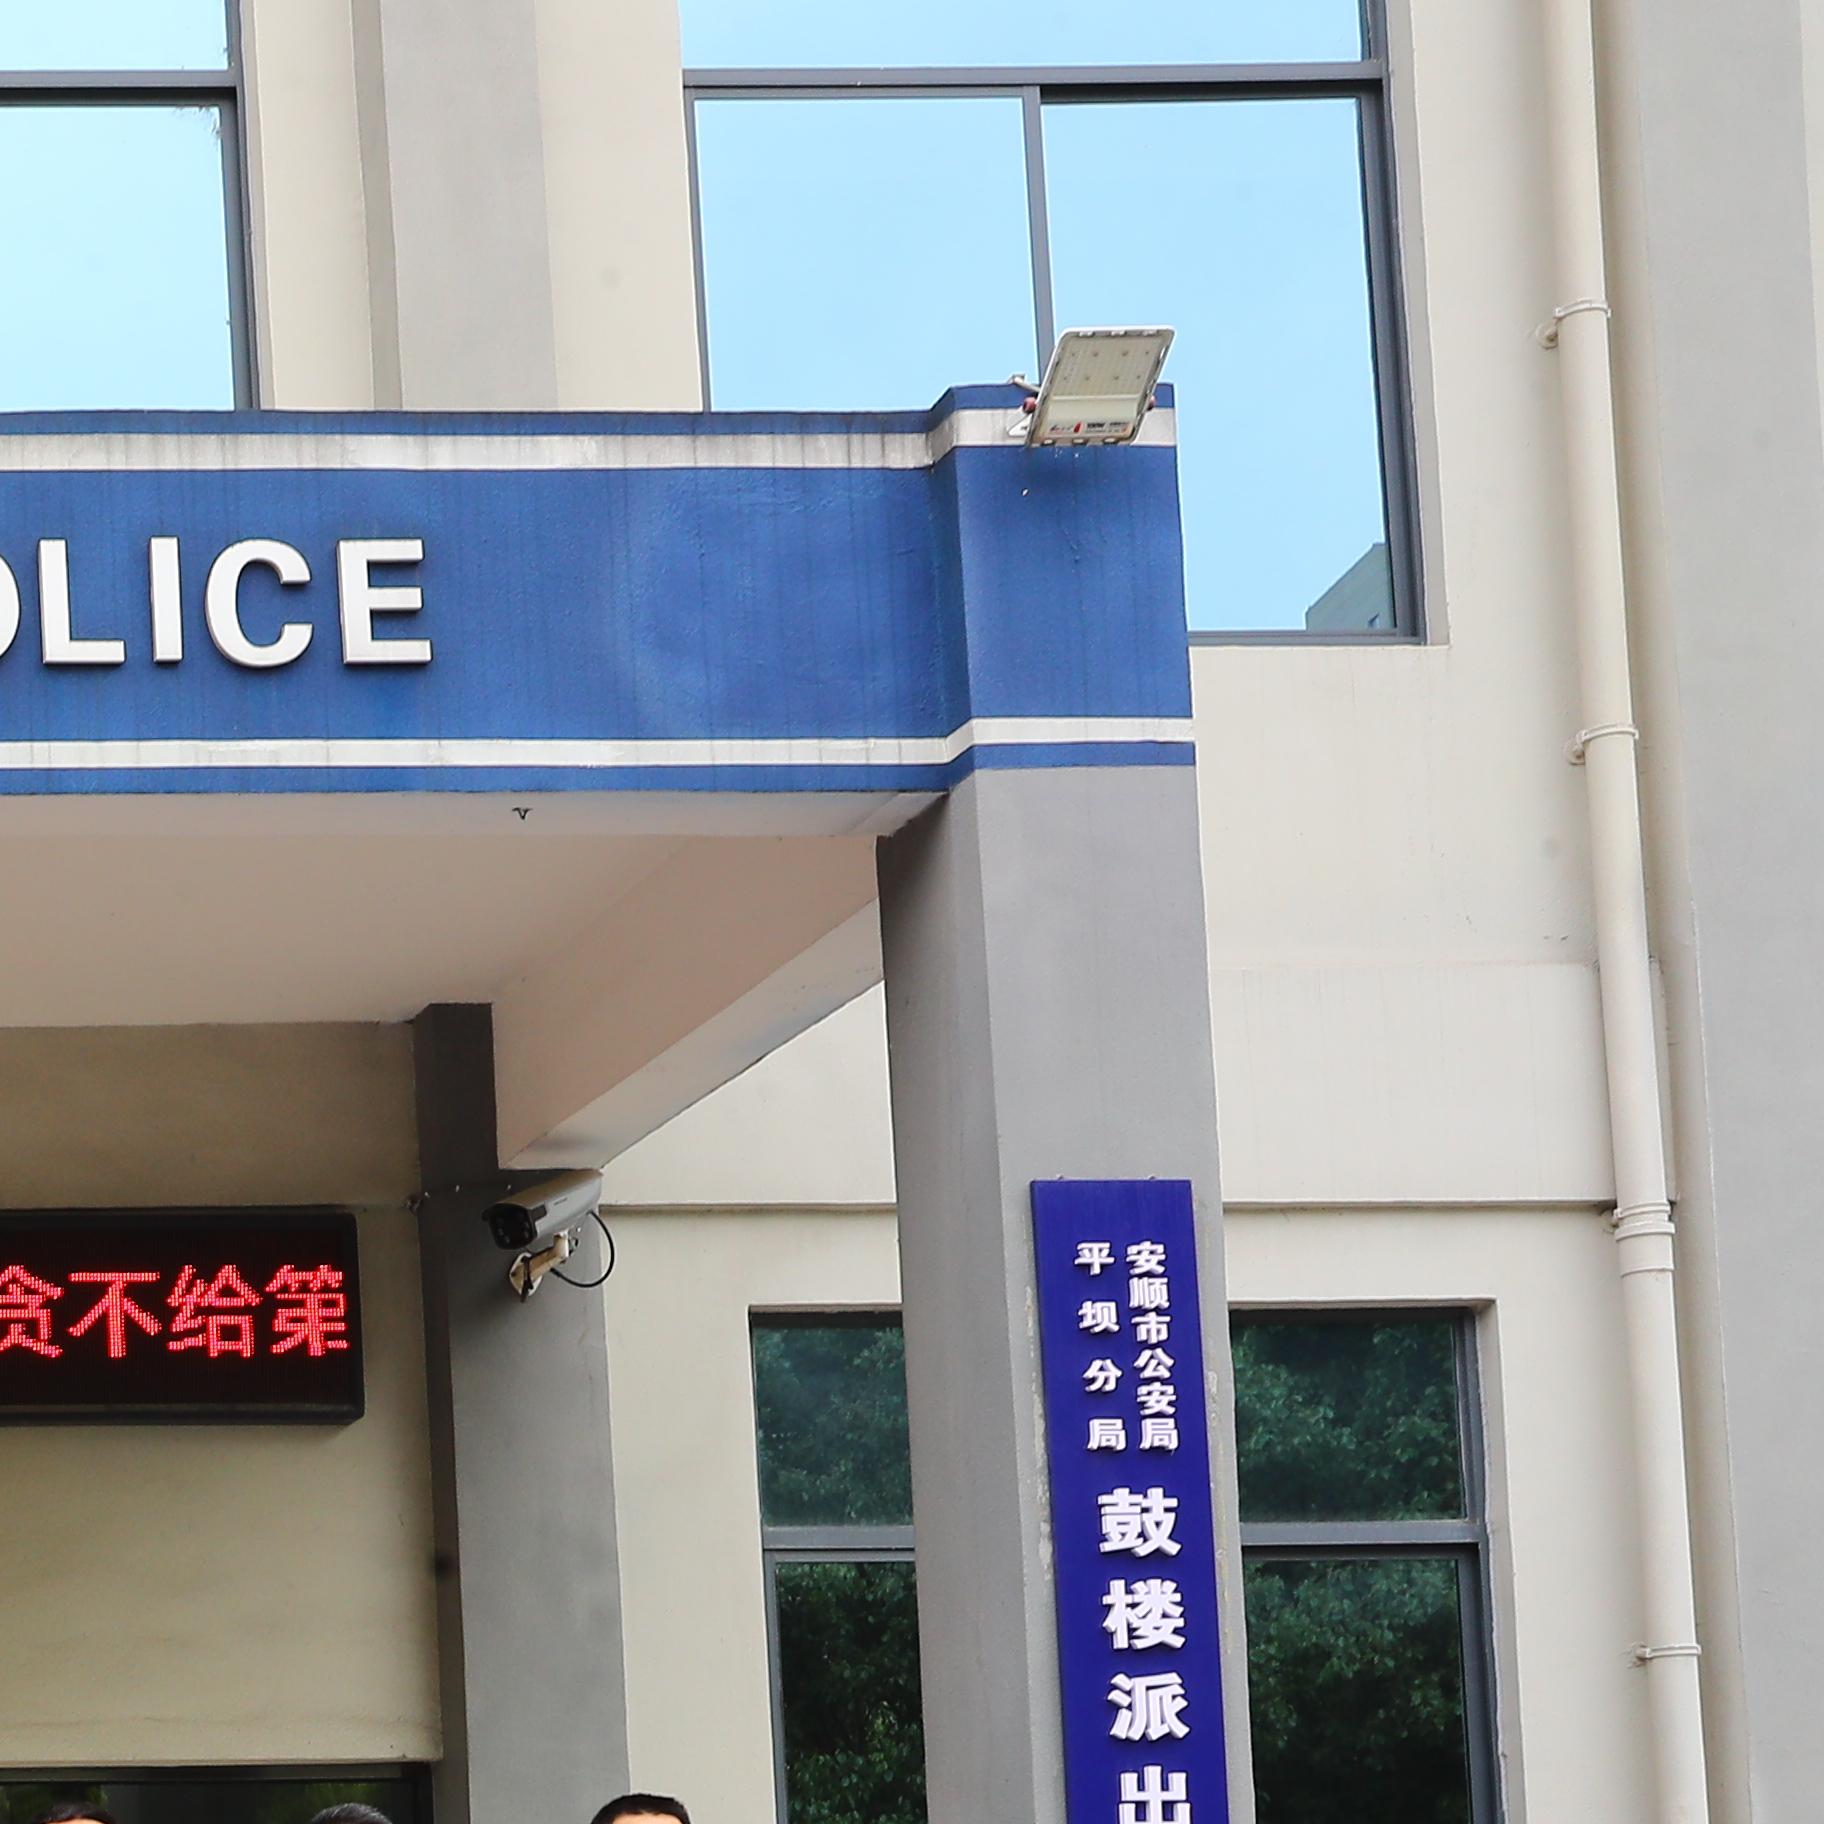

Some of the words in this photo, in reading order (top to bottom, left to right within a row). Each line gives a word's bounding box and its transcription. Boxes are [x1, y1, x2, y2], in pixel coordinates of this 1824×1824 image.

[1073, 1241, 1126, 1451] 平坝分局
[1126, 1240, 1179, 1452] 安顺市公安局
